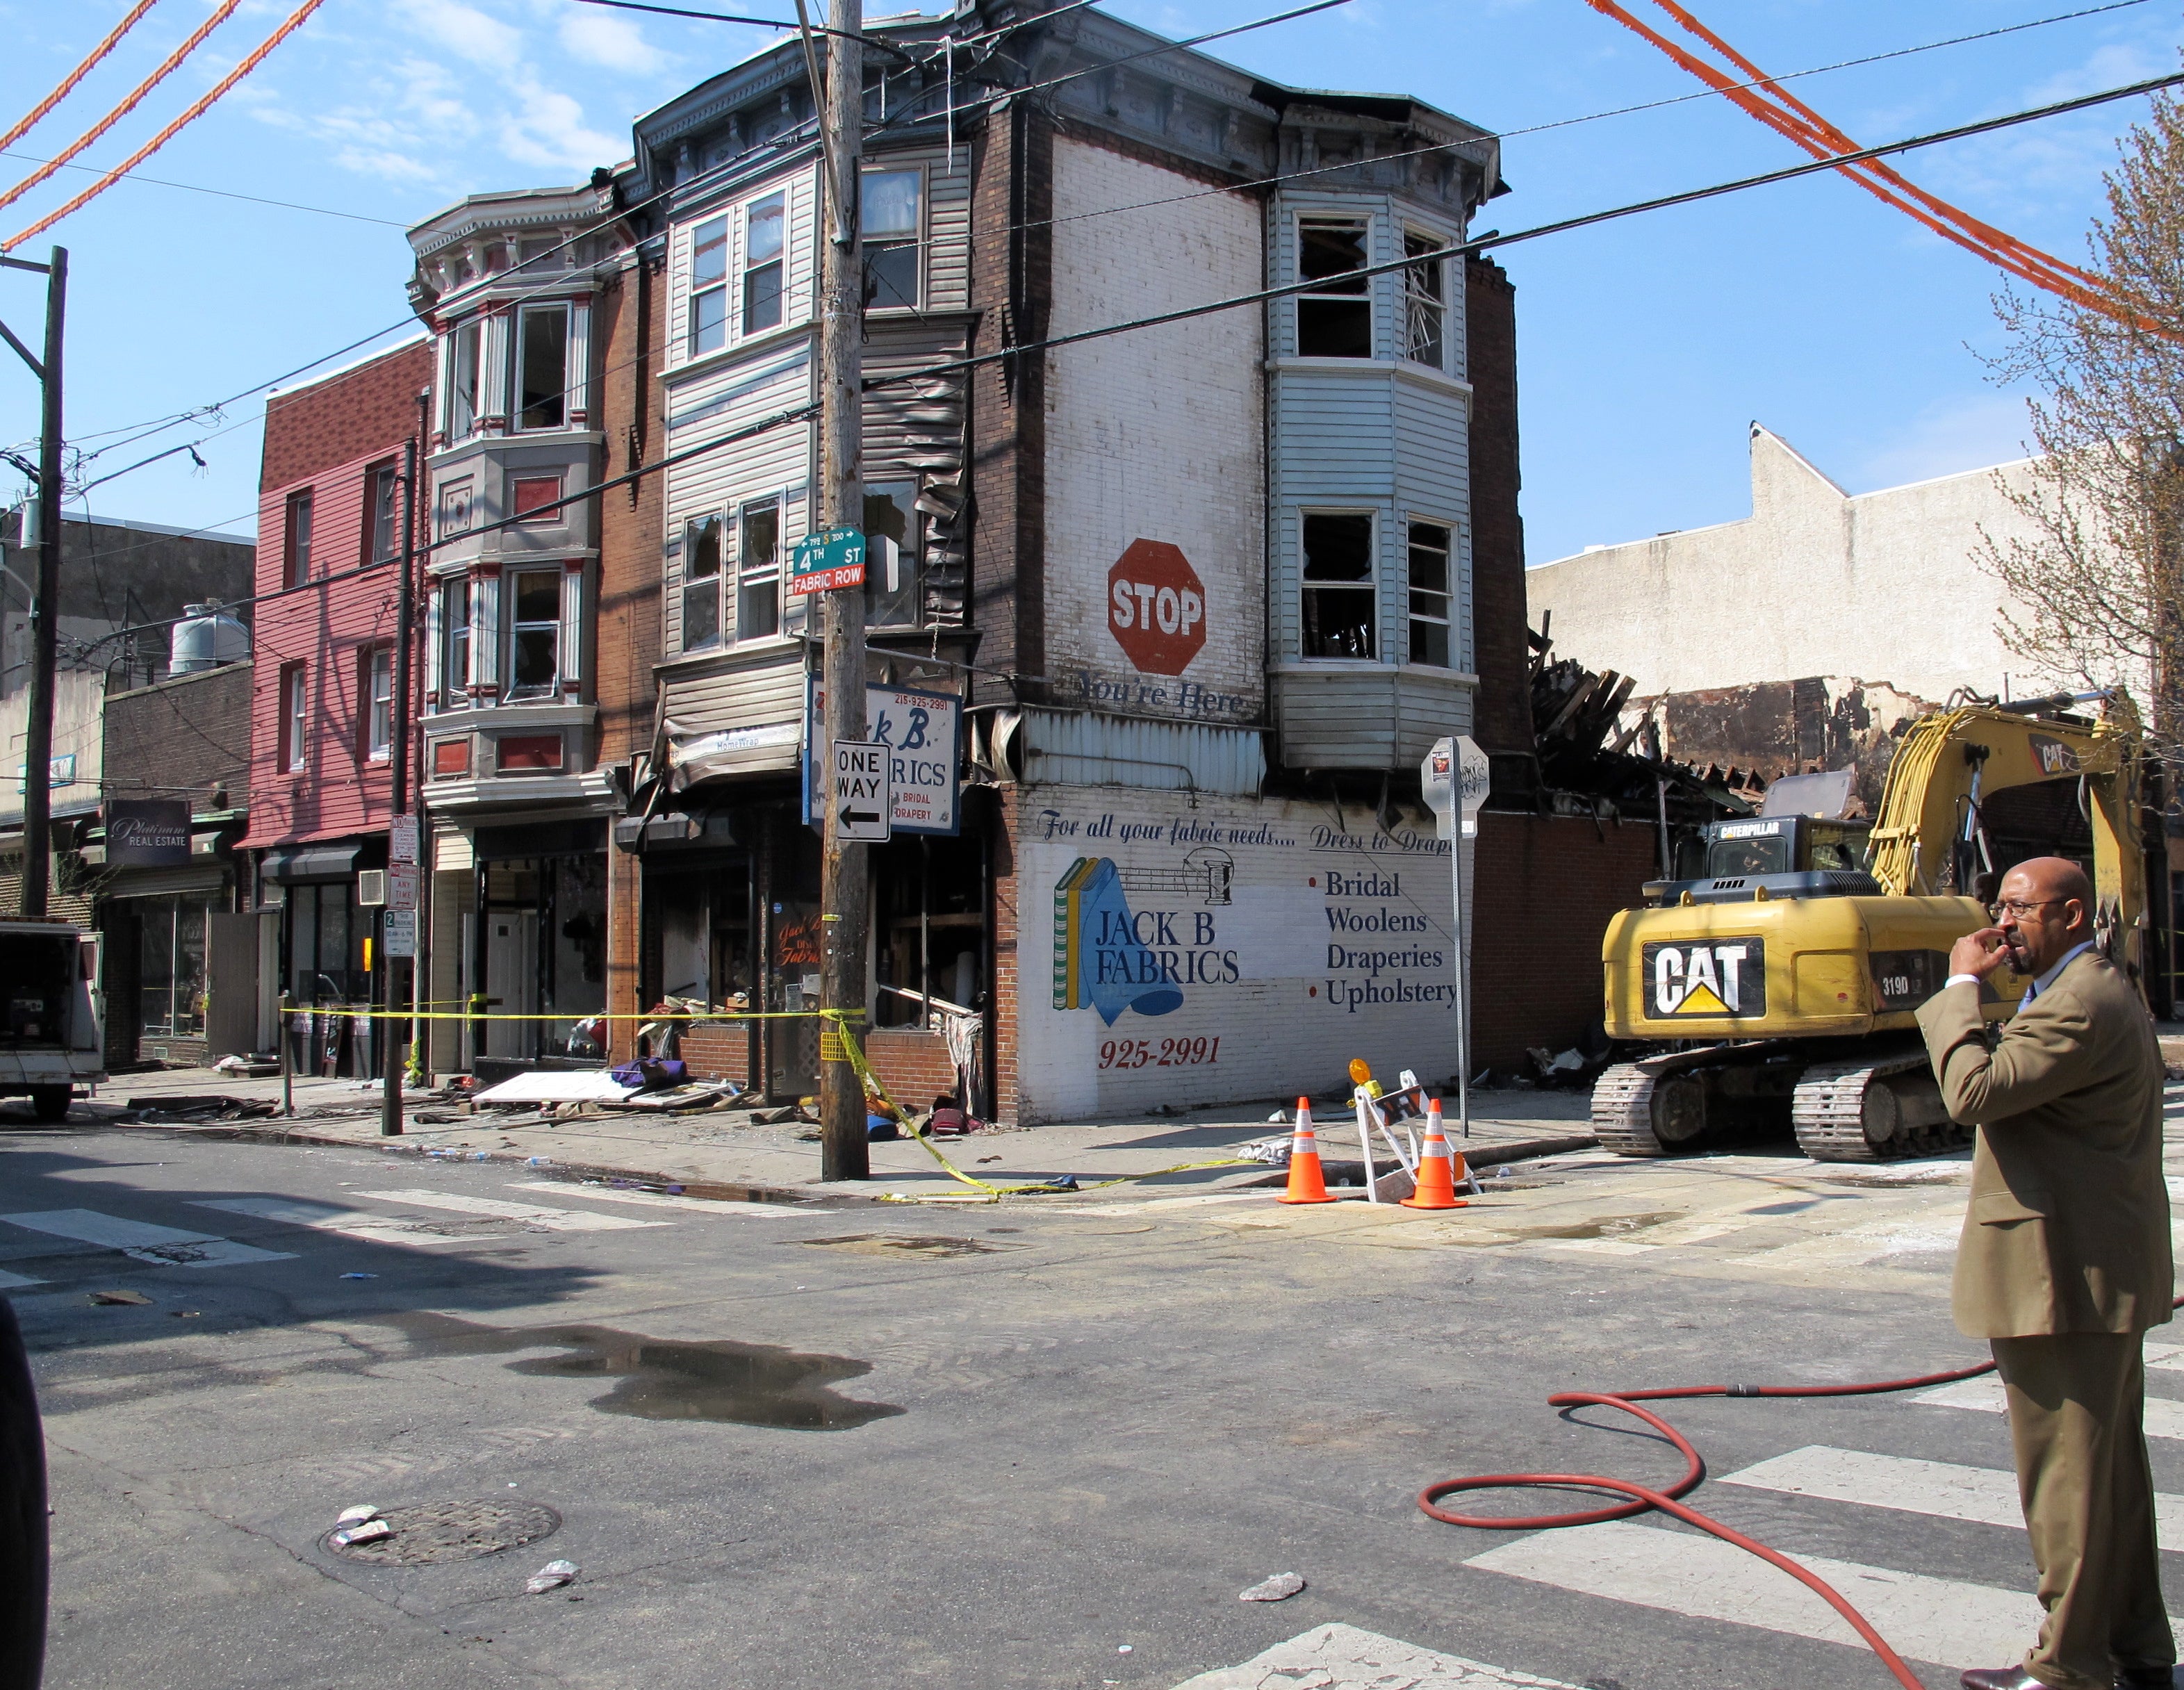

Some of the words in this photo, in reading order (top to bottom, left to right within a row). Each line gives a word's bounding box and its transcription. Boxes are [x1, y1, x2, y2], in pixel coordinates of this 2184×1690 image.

[823, 534, 829, 545] S
[800, 548, 825, 571] 4TH
[844, 547, 862, 564] ST
[794, 573, 831, 593] FABRIC
[835, 567, 861, 585] ROW
[1112, 579, 1201, 636] STOP
[1076, 670, 1167, 705] You're
[1179, 682, 1244, 714] Here
[839, 750, 880, 773] ONE
[2044, 744, 2064, 772] CAT
[838, 776, 880, 798] WAY
[903, 792, 930, 804] BRIDAL
[895, 807, 931, 820] DRAPERY
[111, 817, 186, 841] Platinum
[1037, 809, 1081, 841] For
[1087, 814, 1115, 838] all
[1119, 823, 1163, 845] your
[1170, 819, 1224, 846] fabric
[1310, 825, 1363, 848] Dress
[1372, 831, 1391, 850] to
[1721, 821, 1779, 839] CATERPILLAR
[130, 837, 153, 846] REAL
[156, 837, 186, 846] ESTATE
[396, 890, 411, 899] TIME
[1325, 871, 1400, 898] Bridal
[386, 914, 393, 926] 2
[1096, 911, 1180, 946] JACK
[1194, 911, 1215, 946] B
[1324, 907, 1427, 933] Woolens
[1096, 949, 1239, 985] FABRICS
[1327, 944, 1443, 976] Draperies
[1655, 946, 1748, 1014] CAT
[1883, 976, 1908, 996] 319D
[1326, 978, 1457, 1013] Upholstery
[1098, 1036, 1221, 1070] 925-2991
